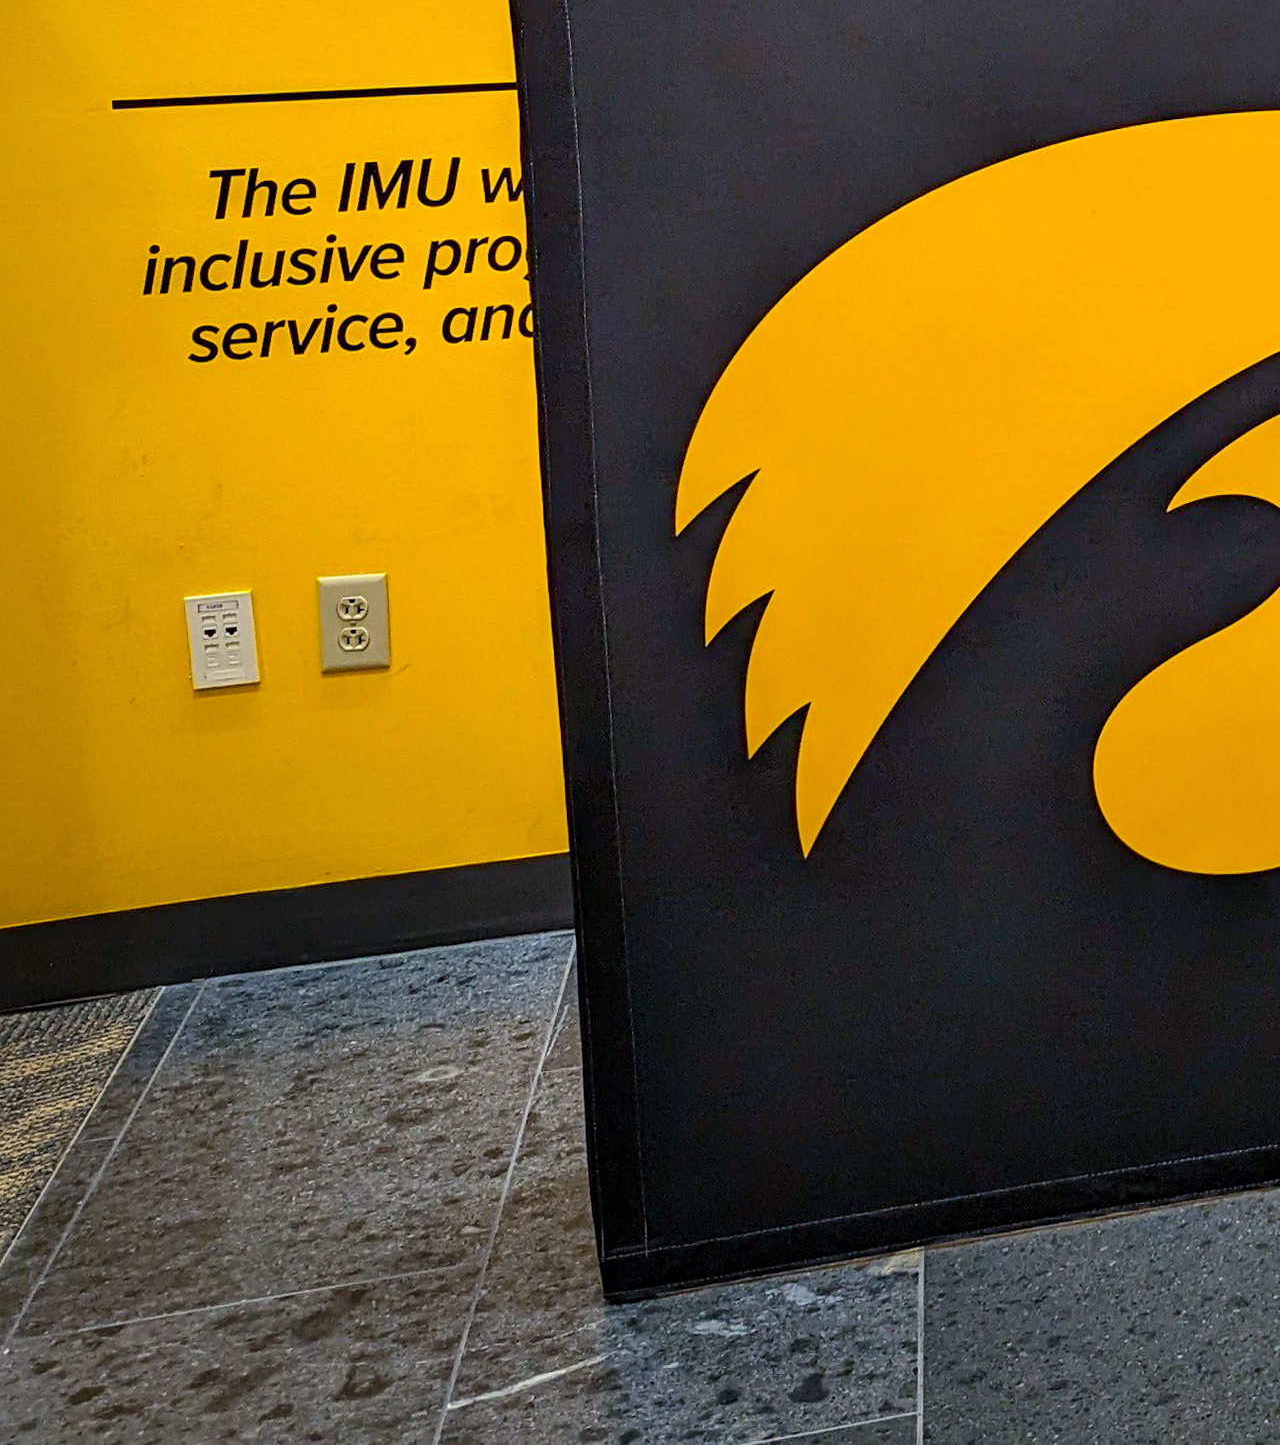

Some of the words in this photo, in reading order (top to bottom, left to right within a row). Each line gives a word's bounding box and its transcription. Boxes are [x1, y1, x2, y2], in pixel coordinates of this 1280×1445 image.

[209, 168, 317, 220] The
[337, 157, 461, 213] IMU
[142, 234, 405, 295] inclusive
[424, 233, 530, 290] pro
[188, 304, 418, 363] service,
